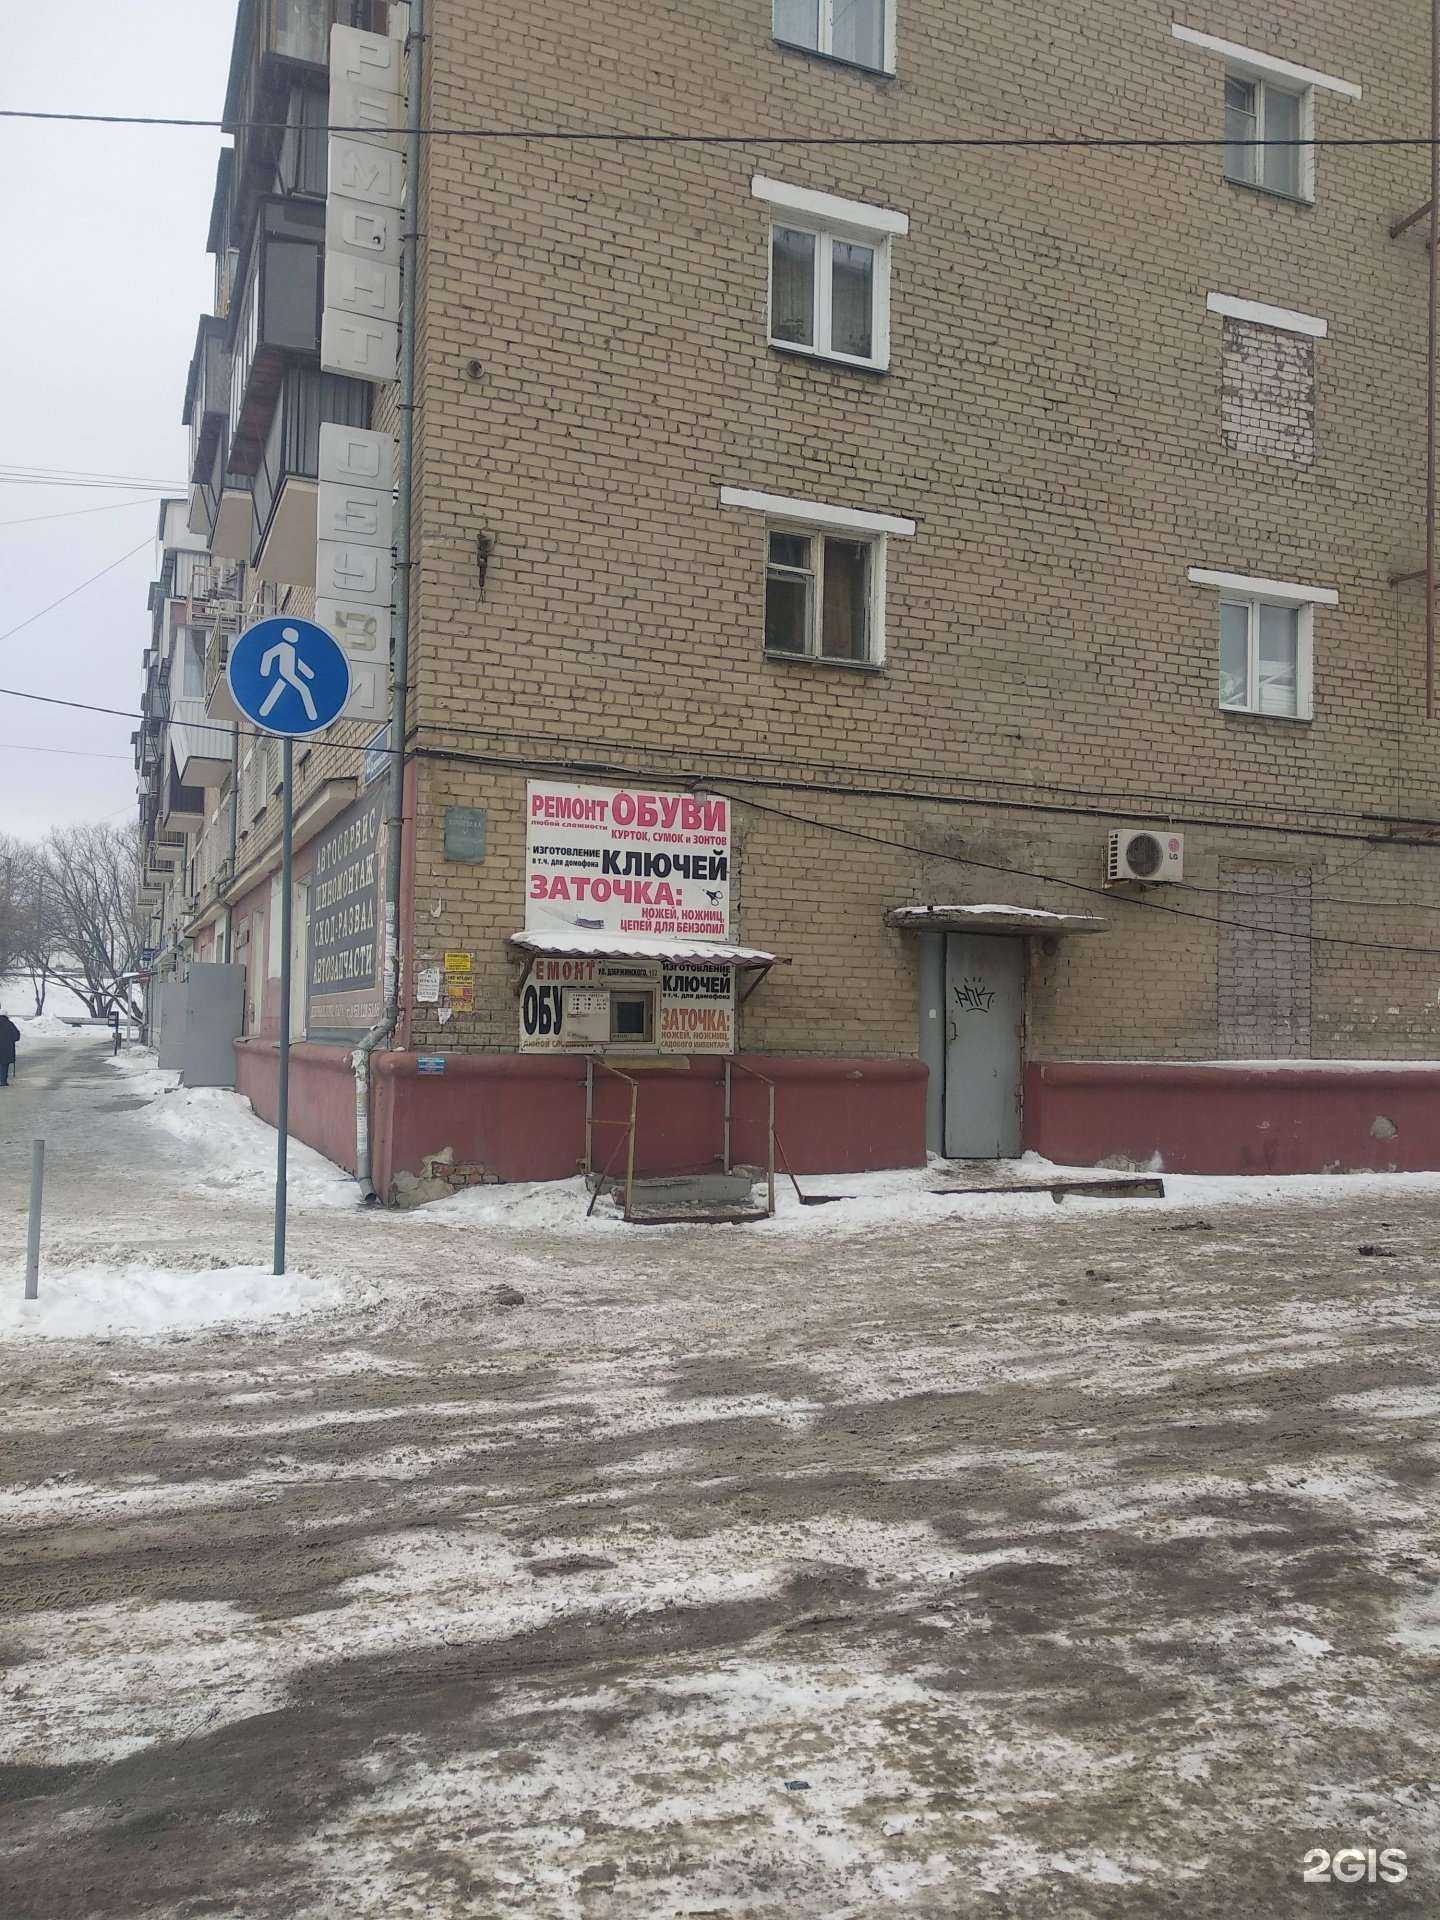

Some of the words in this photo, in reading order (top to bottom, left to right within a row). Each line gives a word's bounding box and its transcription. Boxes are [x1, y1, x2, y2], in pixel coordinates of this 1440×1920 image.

[532, 794, 608, 821] РЕМОНТ
[612, 792, 726, 832] ОБУВИ
[316, 807, 376, 876] АВТОСЕРВИС
[611, 829, 650, 842] КУРТОК,
[653, 832, 683, 844] СУМОК
[693, 834, 727, 846] ЗОНТОВ
[533, 845, 600, 858] ИЗГОТОВЛЕНИЕ
[602, 849, 727, 881] КЛЮЧЕЙ
[565, 859, 599, 869] домофона
[1169, 852, 1178, 860] LG
[530, 874, 682, 906] ЗАТОЧКА:
[314, 897, 374, 948] СХОД-РАЗВАЛ
[620, 918, 652, 932] ЦЕПЕЙ
[654, 921, 674, 933] ДЛЯ
[677, 922, 725, 934] БЕНЗОПИЛ
[641, 906, 679, 920] НОЖЕЙ,
[681, 910, 725, 923] НОЖНИЦ,
[312, 943, 373, 985] АВТОЗАПЧАСТИ
[535, 960, 594, 981] ЕМОНТ
[662, 972, 731, 994] КЛЮЧЕЙ
[662, 1007, 729, 1032] ЗАТОЧКА:
